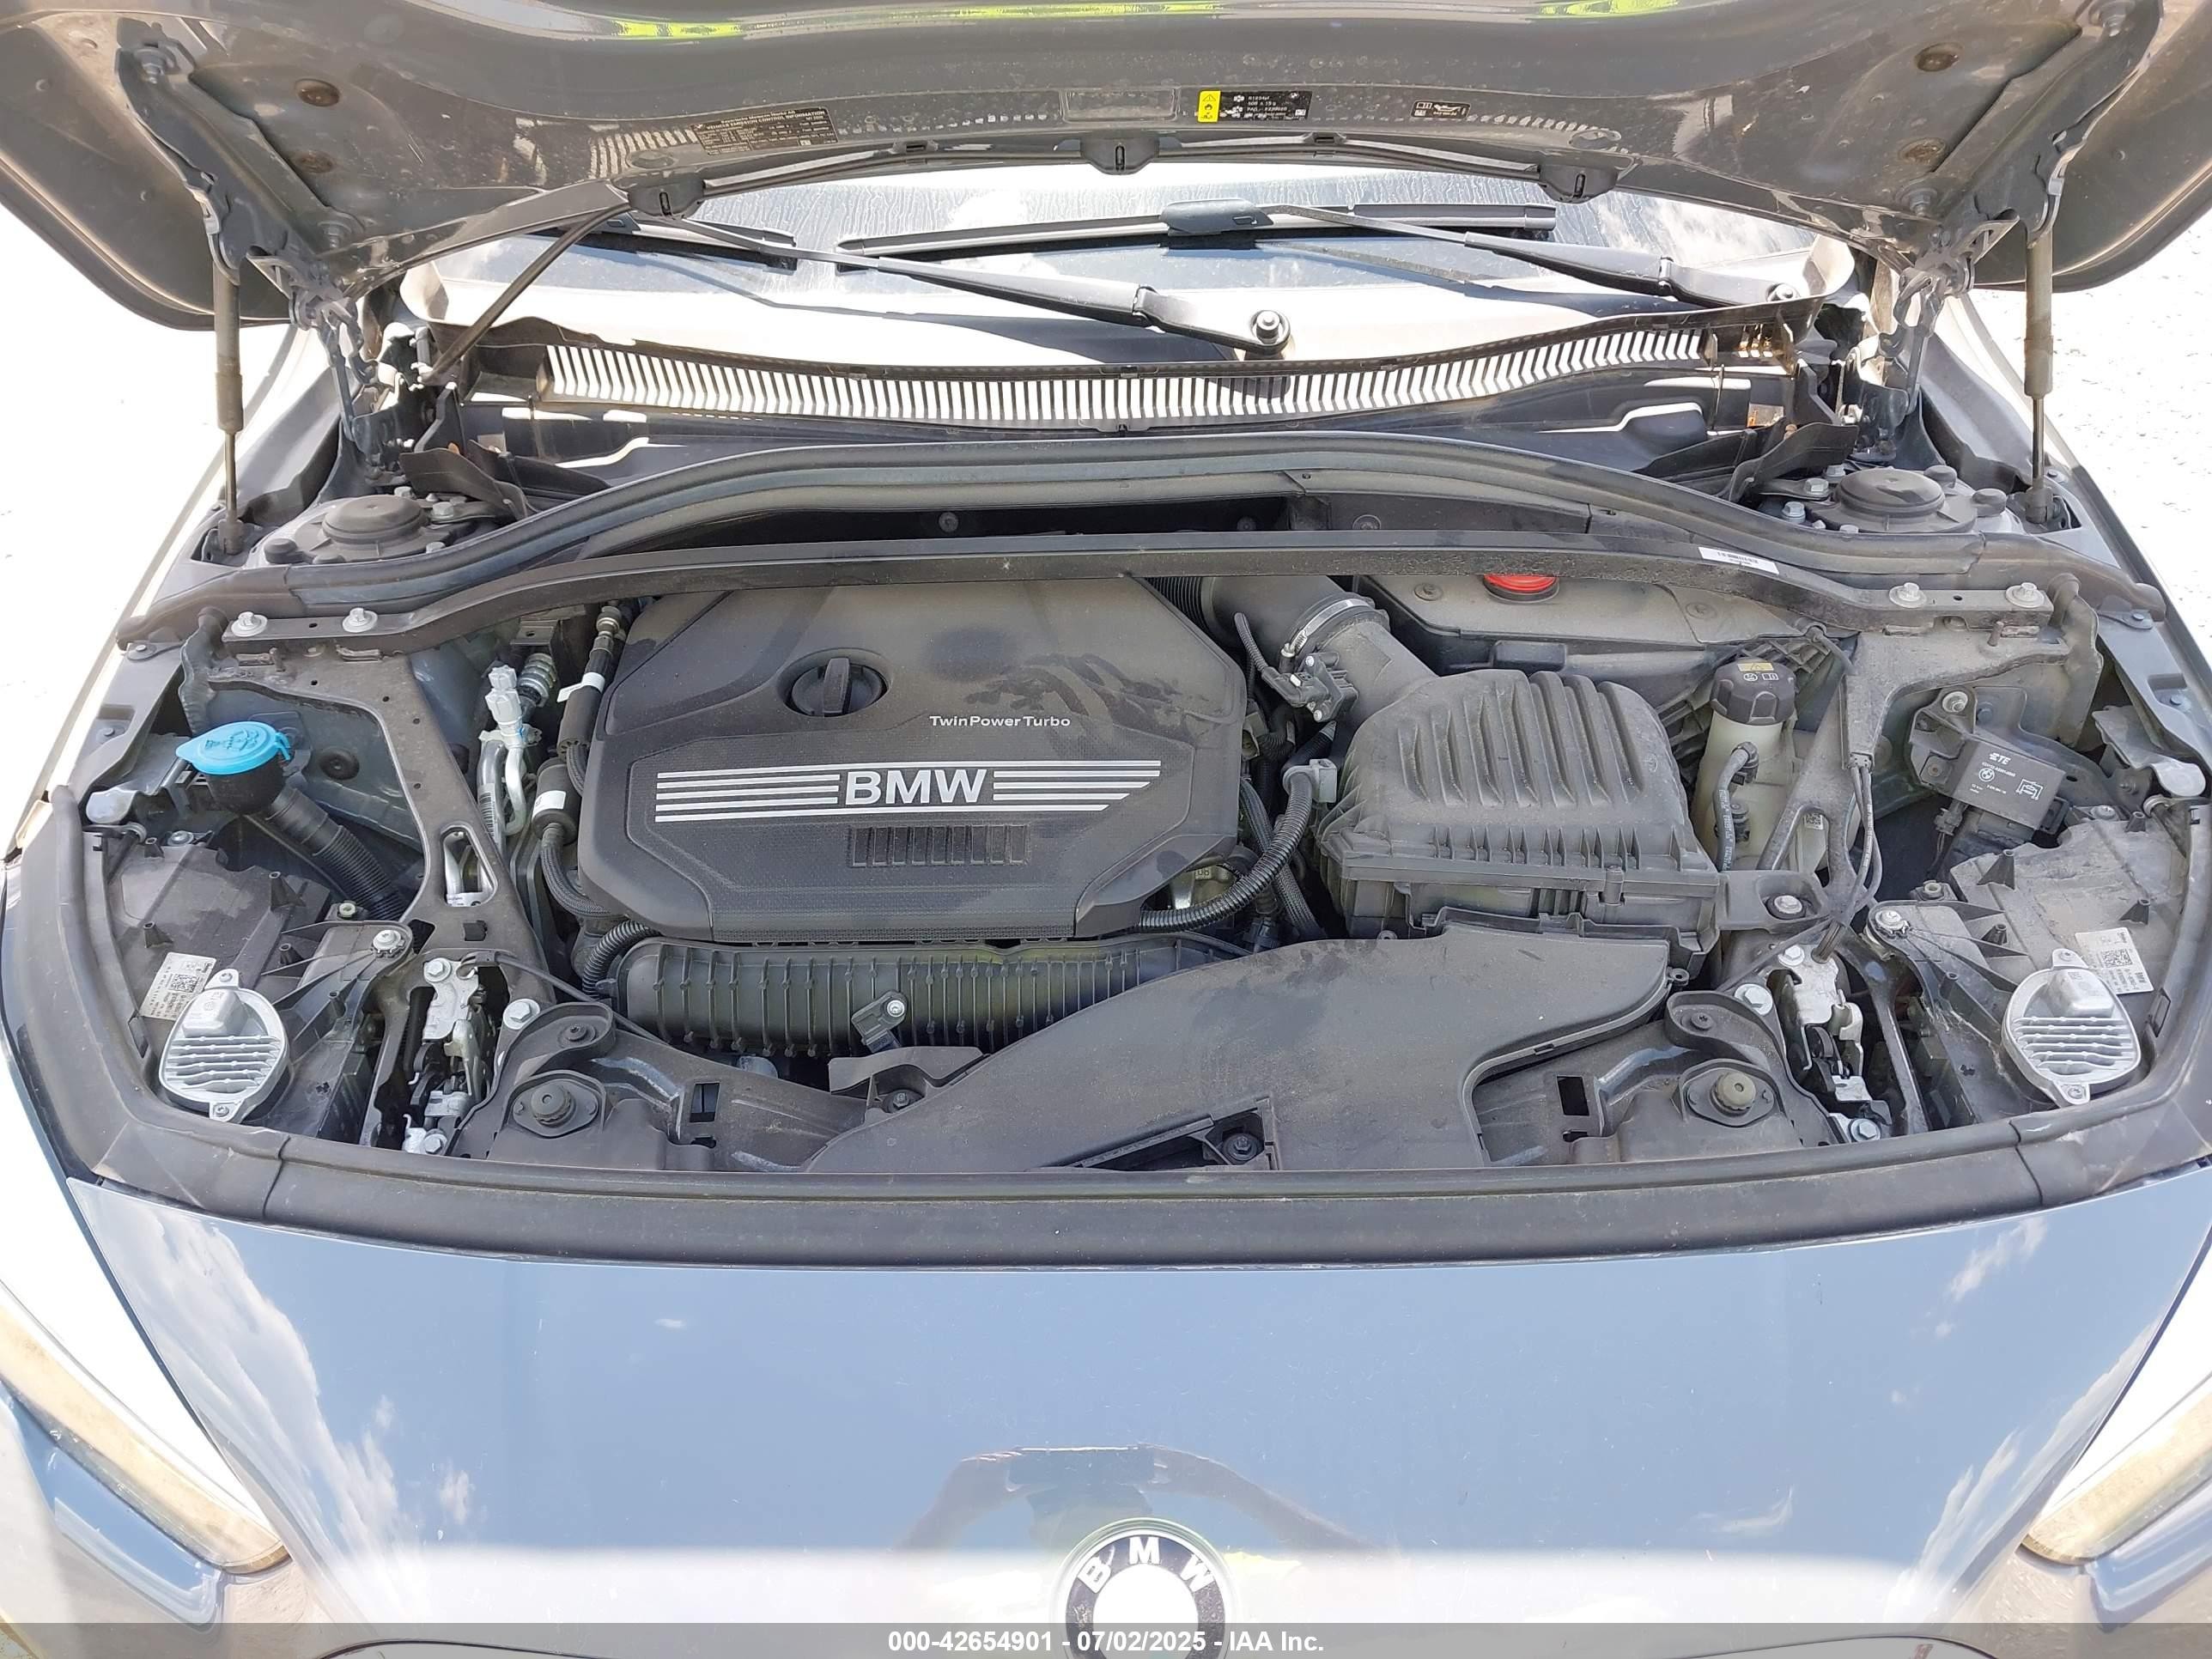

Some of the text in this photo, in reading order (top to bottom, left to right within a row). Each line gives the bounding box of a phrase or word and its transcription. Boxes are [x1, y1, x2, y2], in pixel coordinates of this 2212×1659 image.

[1022, 715, 1071, 726] Turbo
[845, 769, 988, 805] BMW
[1077, 1536, 1216, 1594] BMW
